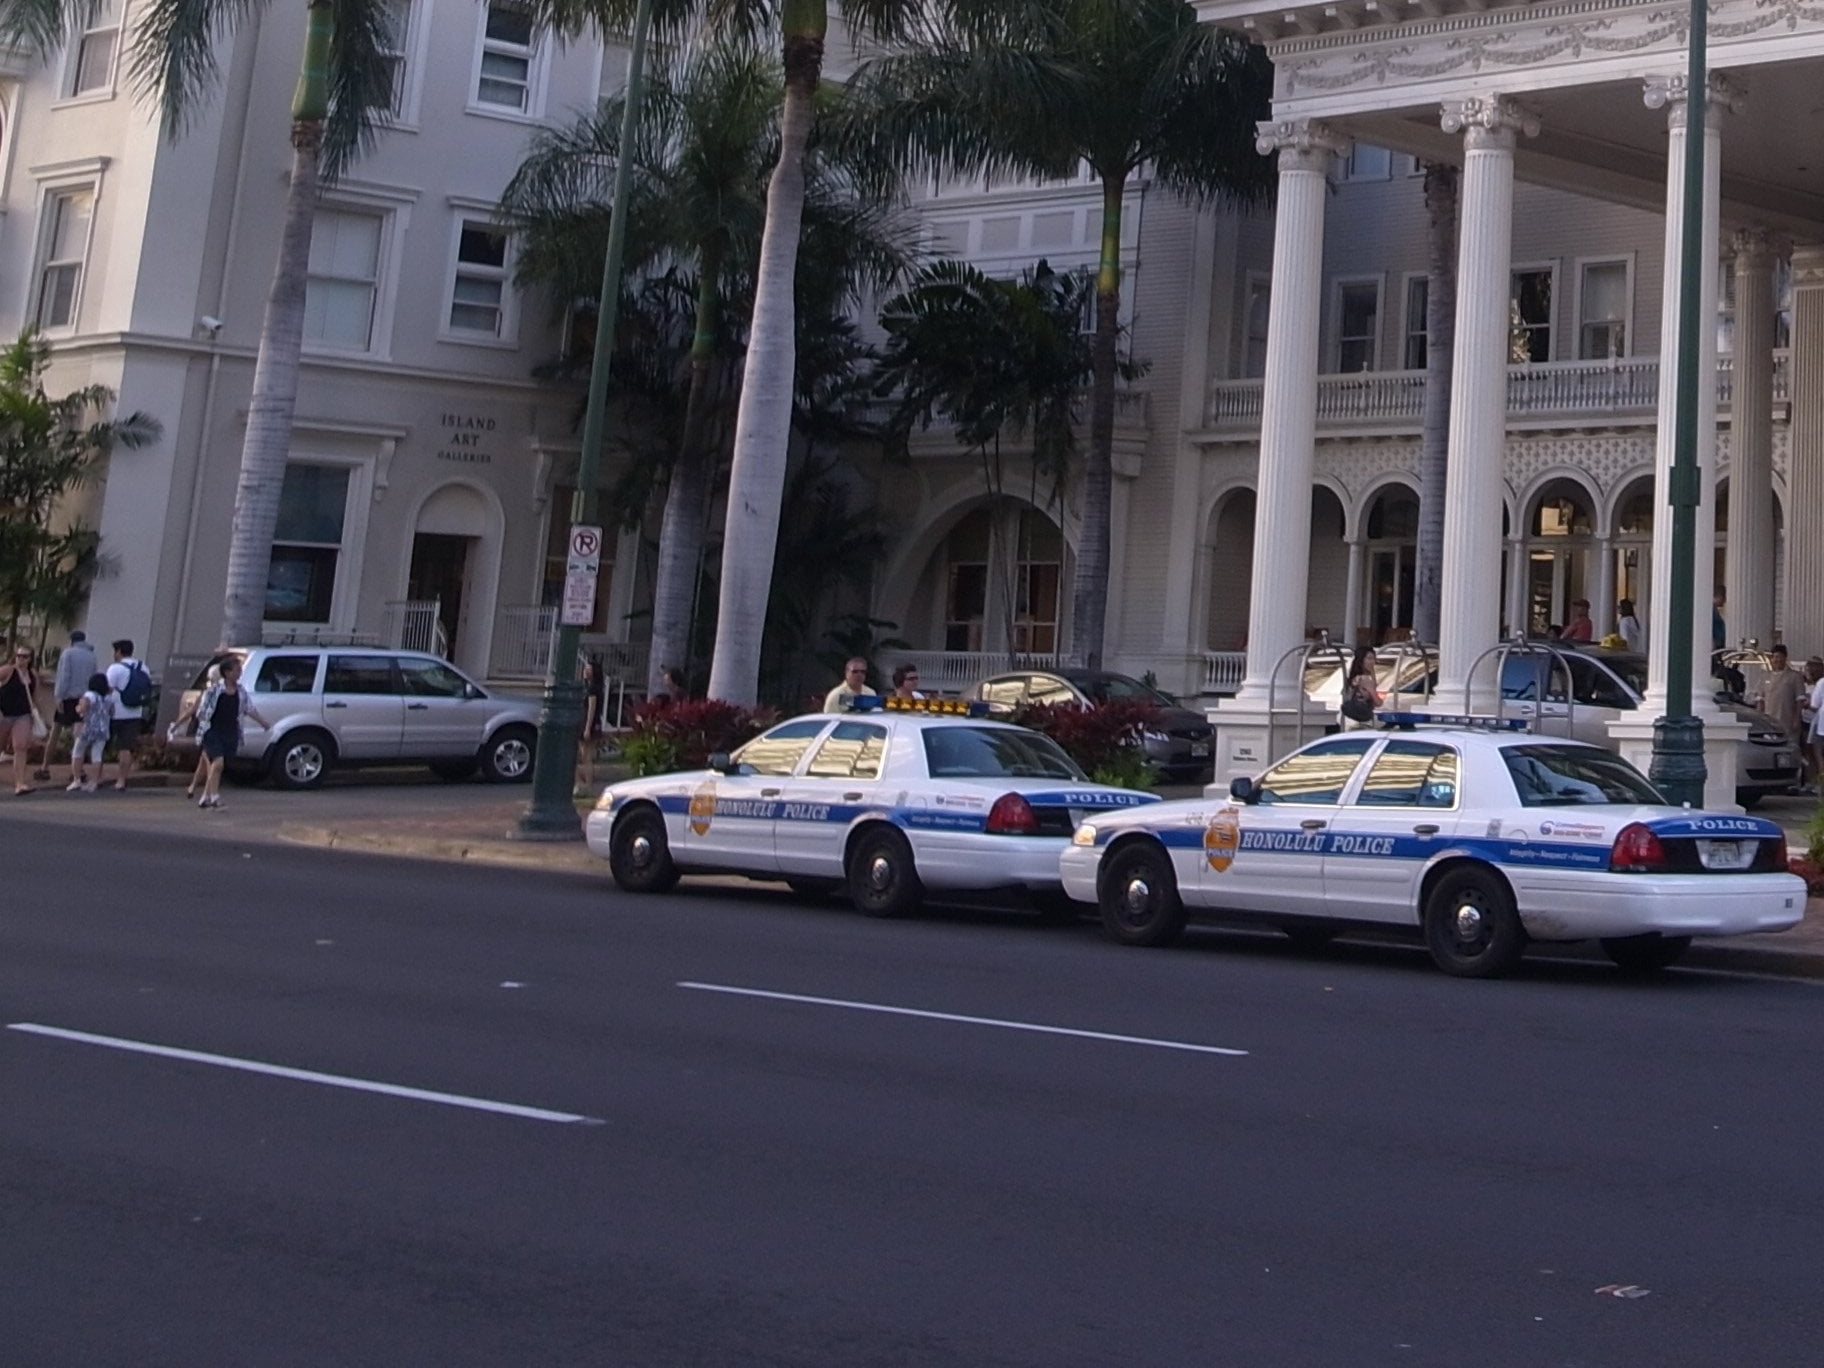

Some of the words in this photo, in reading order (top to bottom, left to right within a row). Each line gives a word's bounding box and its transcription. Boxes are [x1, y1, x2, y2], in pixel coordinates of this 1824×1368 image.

[441, 413, 496, 431] ISLAND
[450, 433, 480, 447] ART
[1065, 792, 1140, 806] POLICE
[717, 800, 776, 818] HONOLULU
[782, 803, 831, 820] POLICE
[1687, 819, 1758, 831] POLICE
[1242, 832, 1326, 851] HONOLULU
[1331, 836, 1395, 854] POLICE
